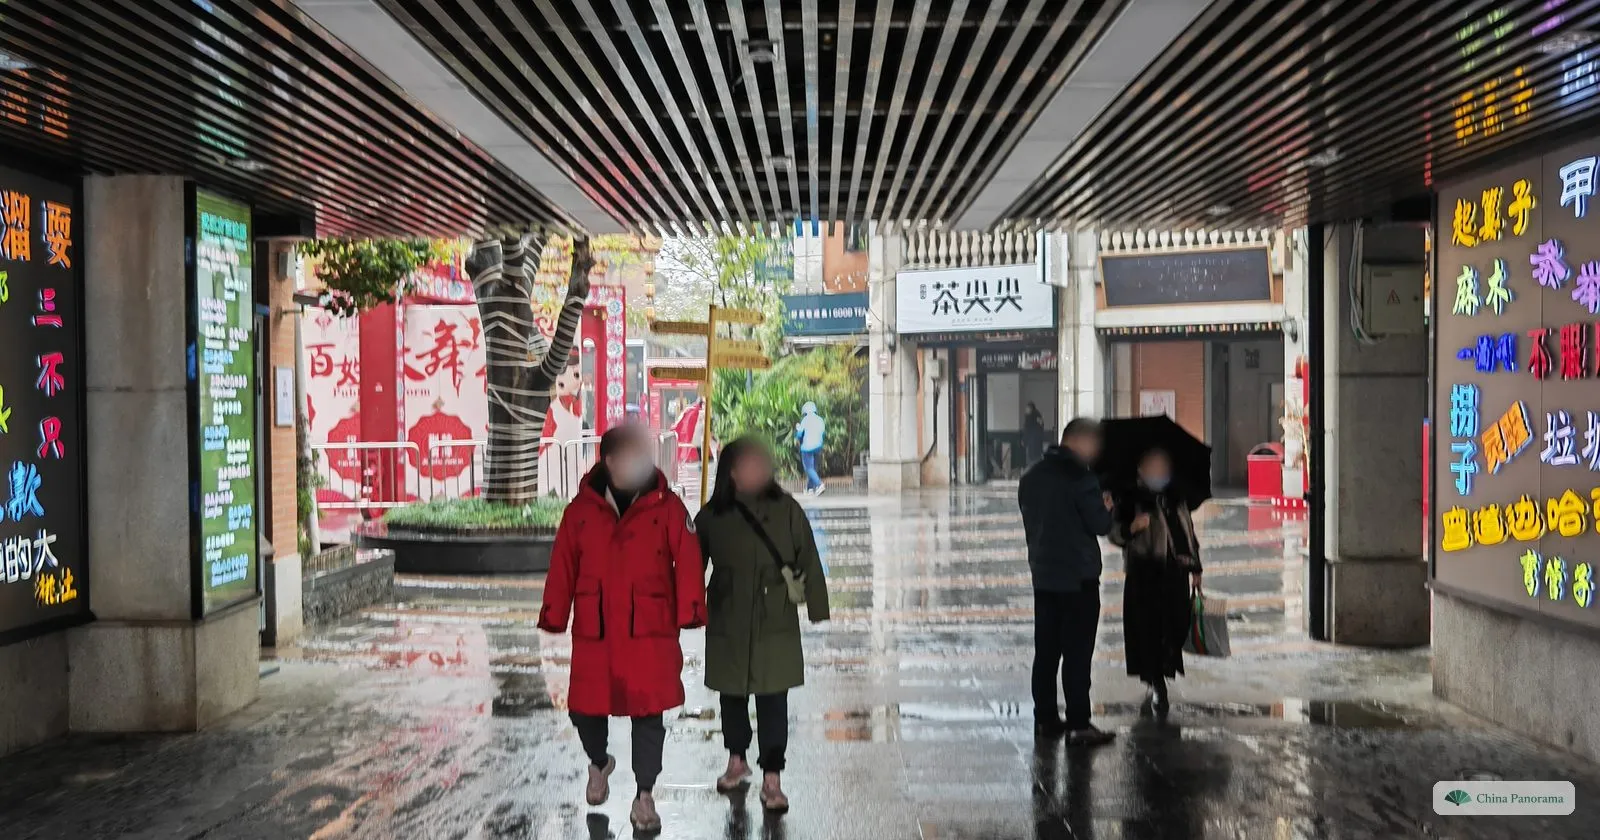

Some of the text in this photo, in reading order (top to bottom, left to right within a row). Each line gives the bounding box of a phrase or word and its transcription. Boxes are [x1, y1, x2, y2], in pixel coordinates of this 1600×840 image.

[932, 277, 1023, 315] 茶尖尖
[1453, 256, 1513, 316] 麻木
[1526, 321, 1600, 380] 不服
[0, 460, 45, 522] 款
